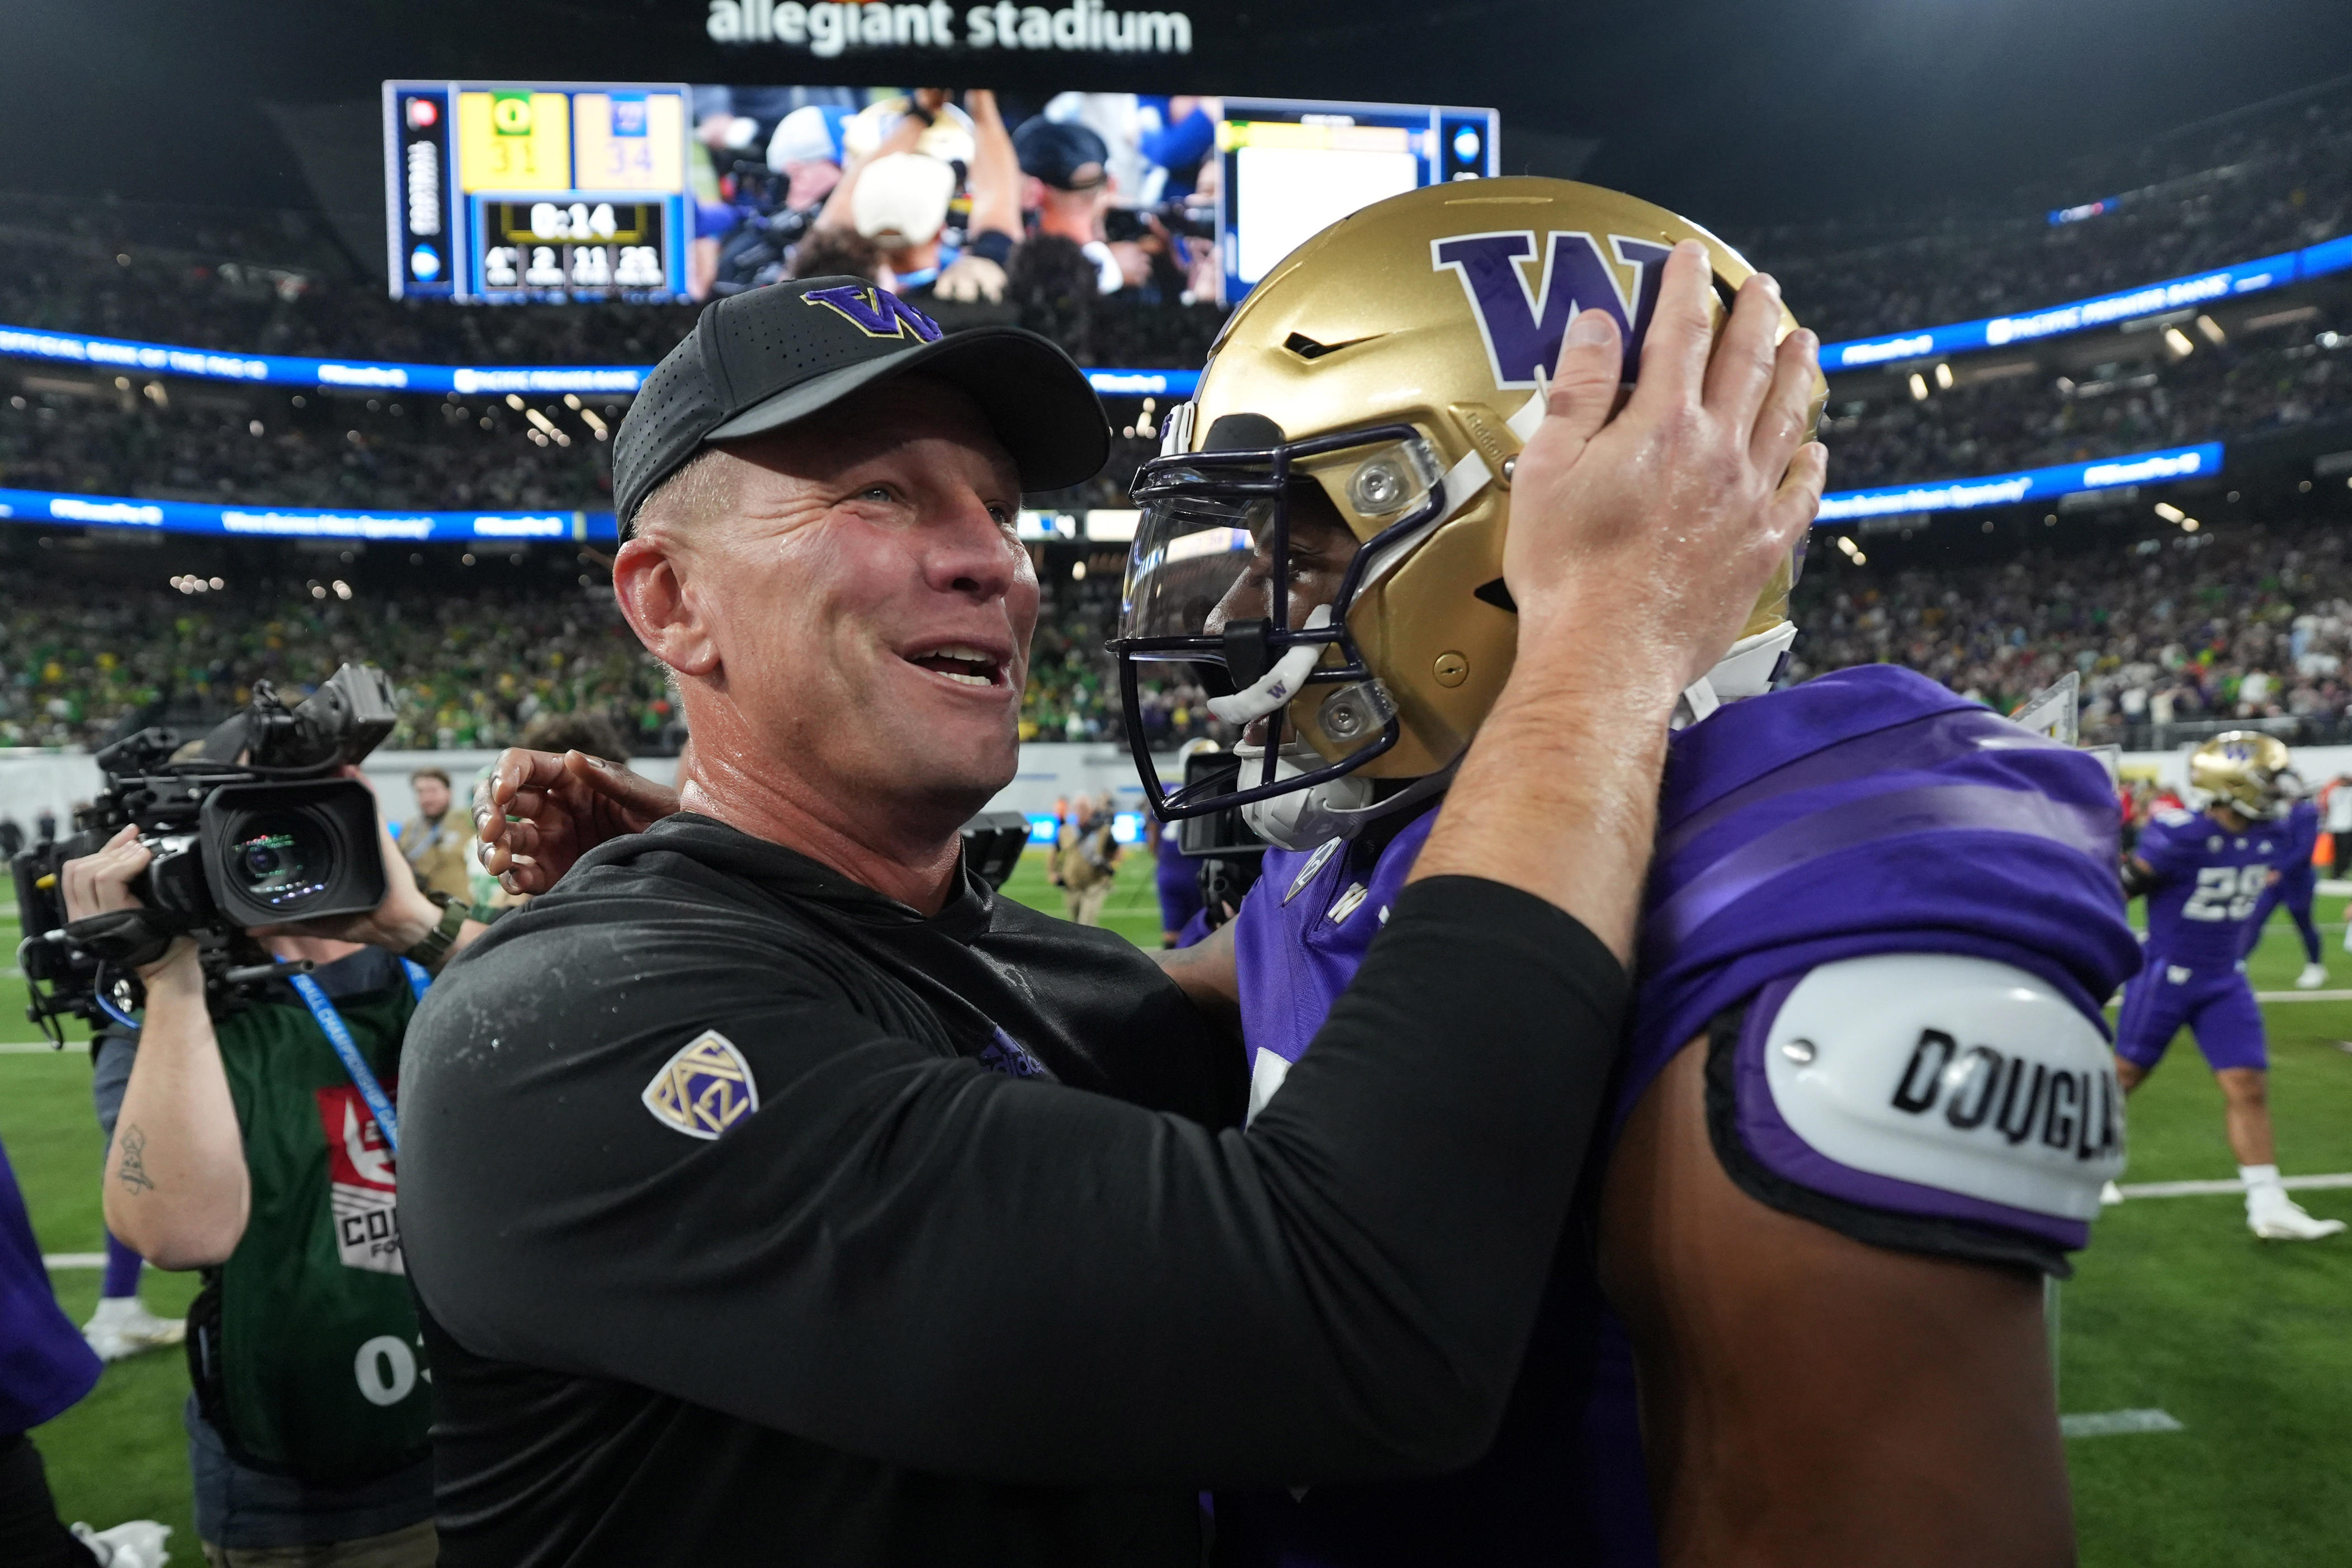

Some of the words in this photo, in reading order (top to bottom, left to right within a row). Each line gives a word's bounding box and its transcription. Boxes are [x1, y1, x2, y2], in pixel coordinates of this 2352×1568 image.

[706, 0, 955, 56] allegiant
[966, 0, 1193, 54] stadium
[799, 285, 944, 344] W
[1430, 230, 1675, 390] W
[1267, 679, 1286, 698] W
[354, 1333, 432, 1407] 0
